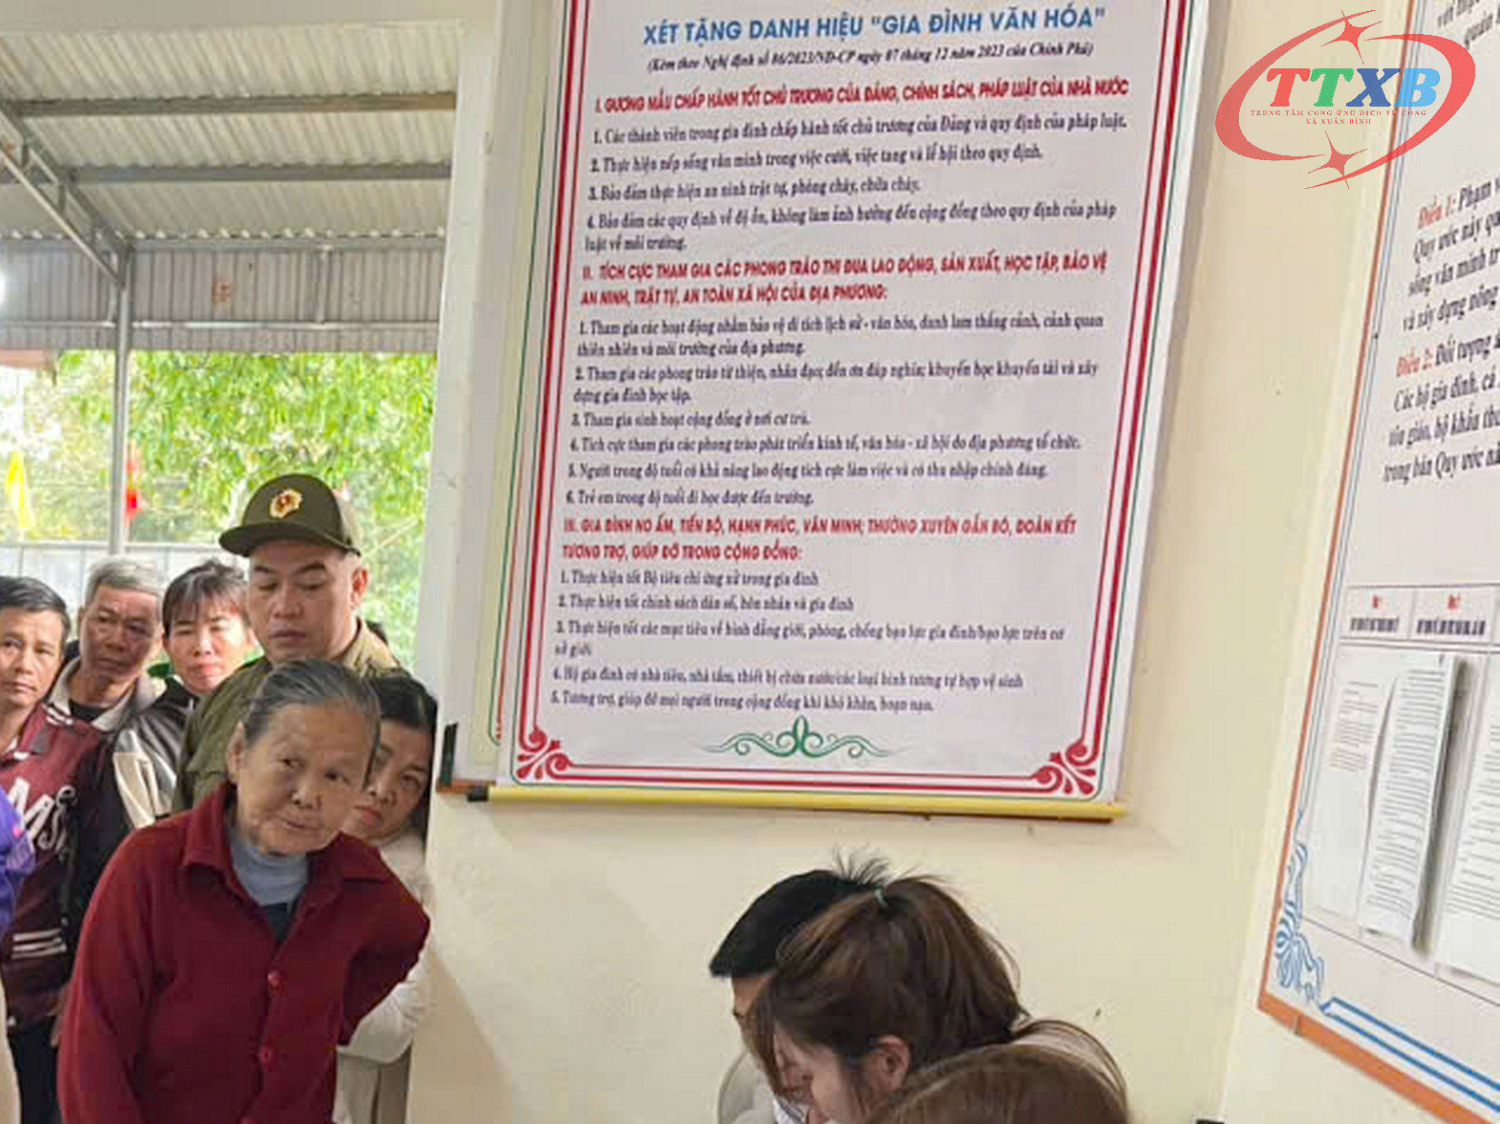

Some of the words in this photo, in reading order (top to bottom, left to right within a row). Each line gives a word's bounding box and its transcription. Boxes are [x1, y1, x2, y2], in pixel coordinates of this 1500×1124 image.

[643, 18, 680, 44] XÉT
[684, 16, 742, 47] TẶNG
[748, 17, 810, 40] DANH
[815, 10, 863, 42] HIỆU
[869, 13, 922, 35] "GIA
[928, 7, 983, 33] ĐÌNH
[989, 5, 1037, 30] VĂN
[1043, 1, 1106, 29] HÓA"
